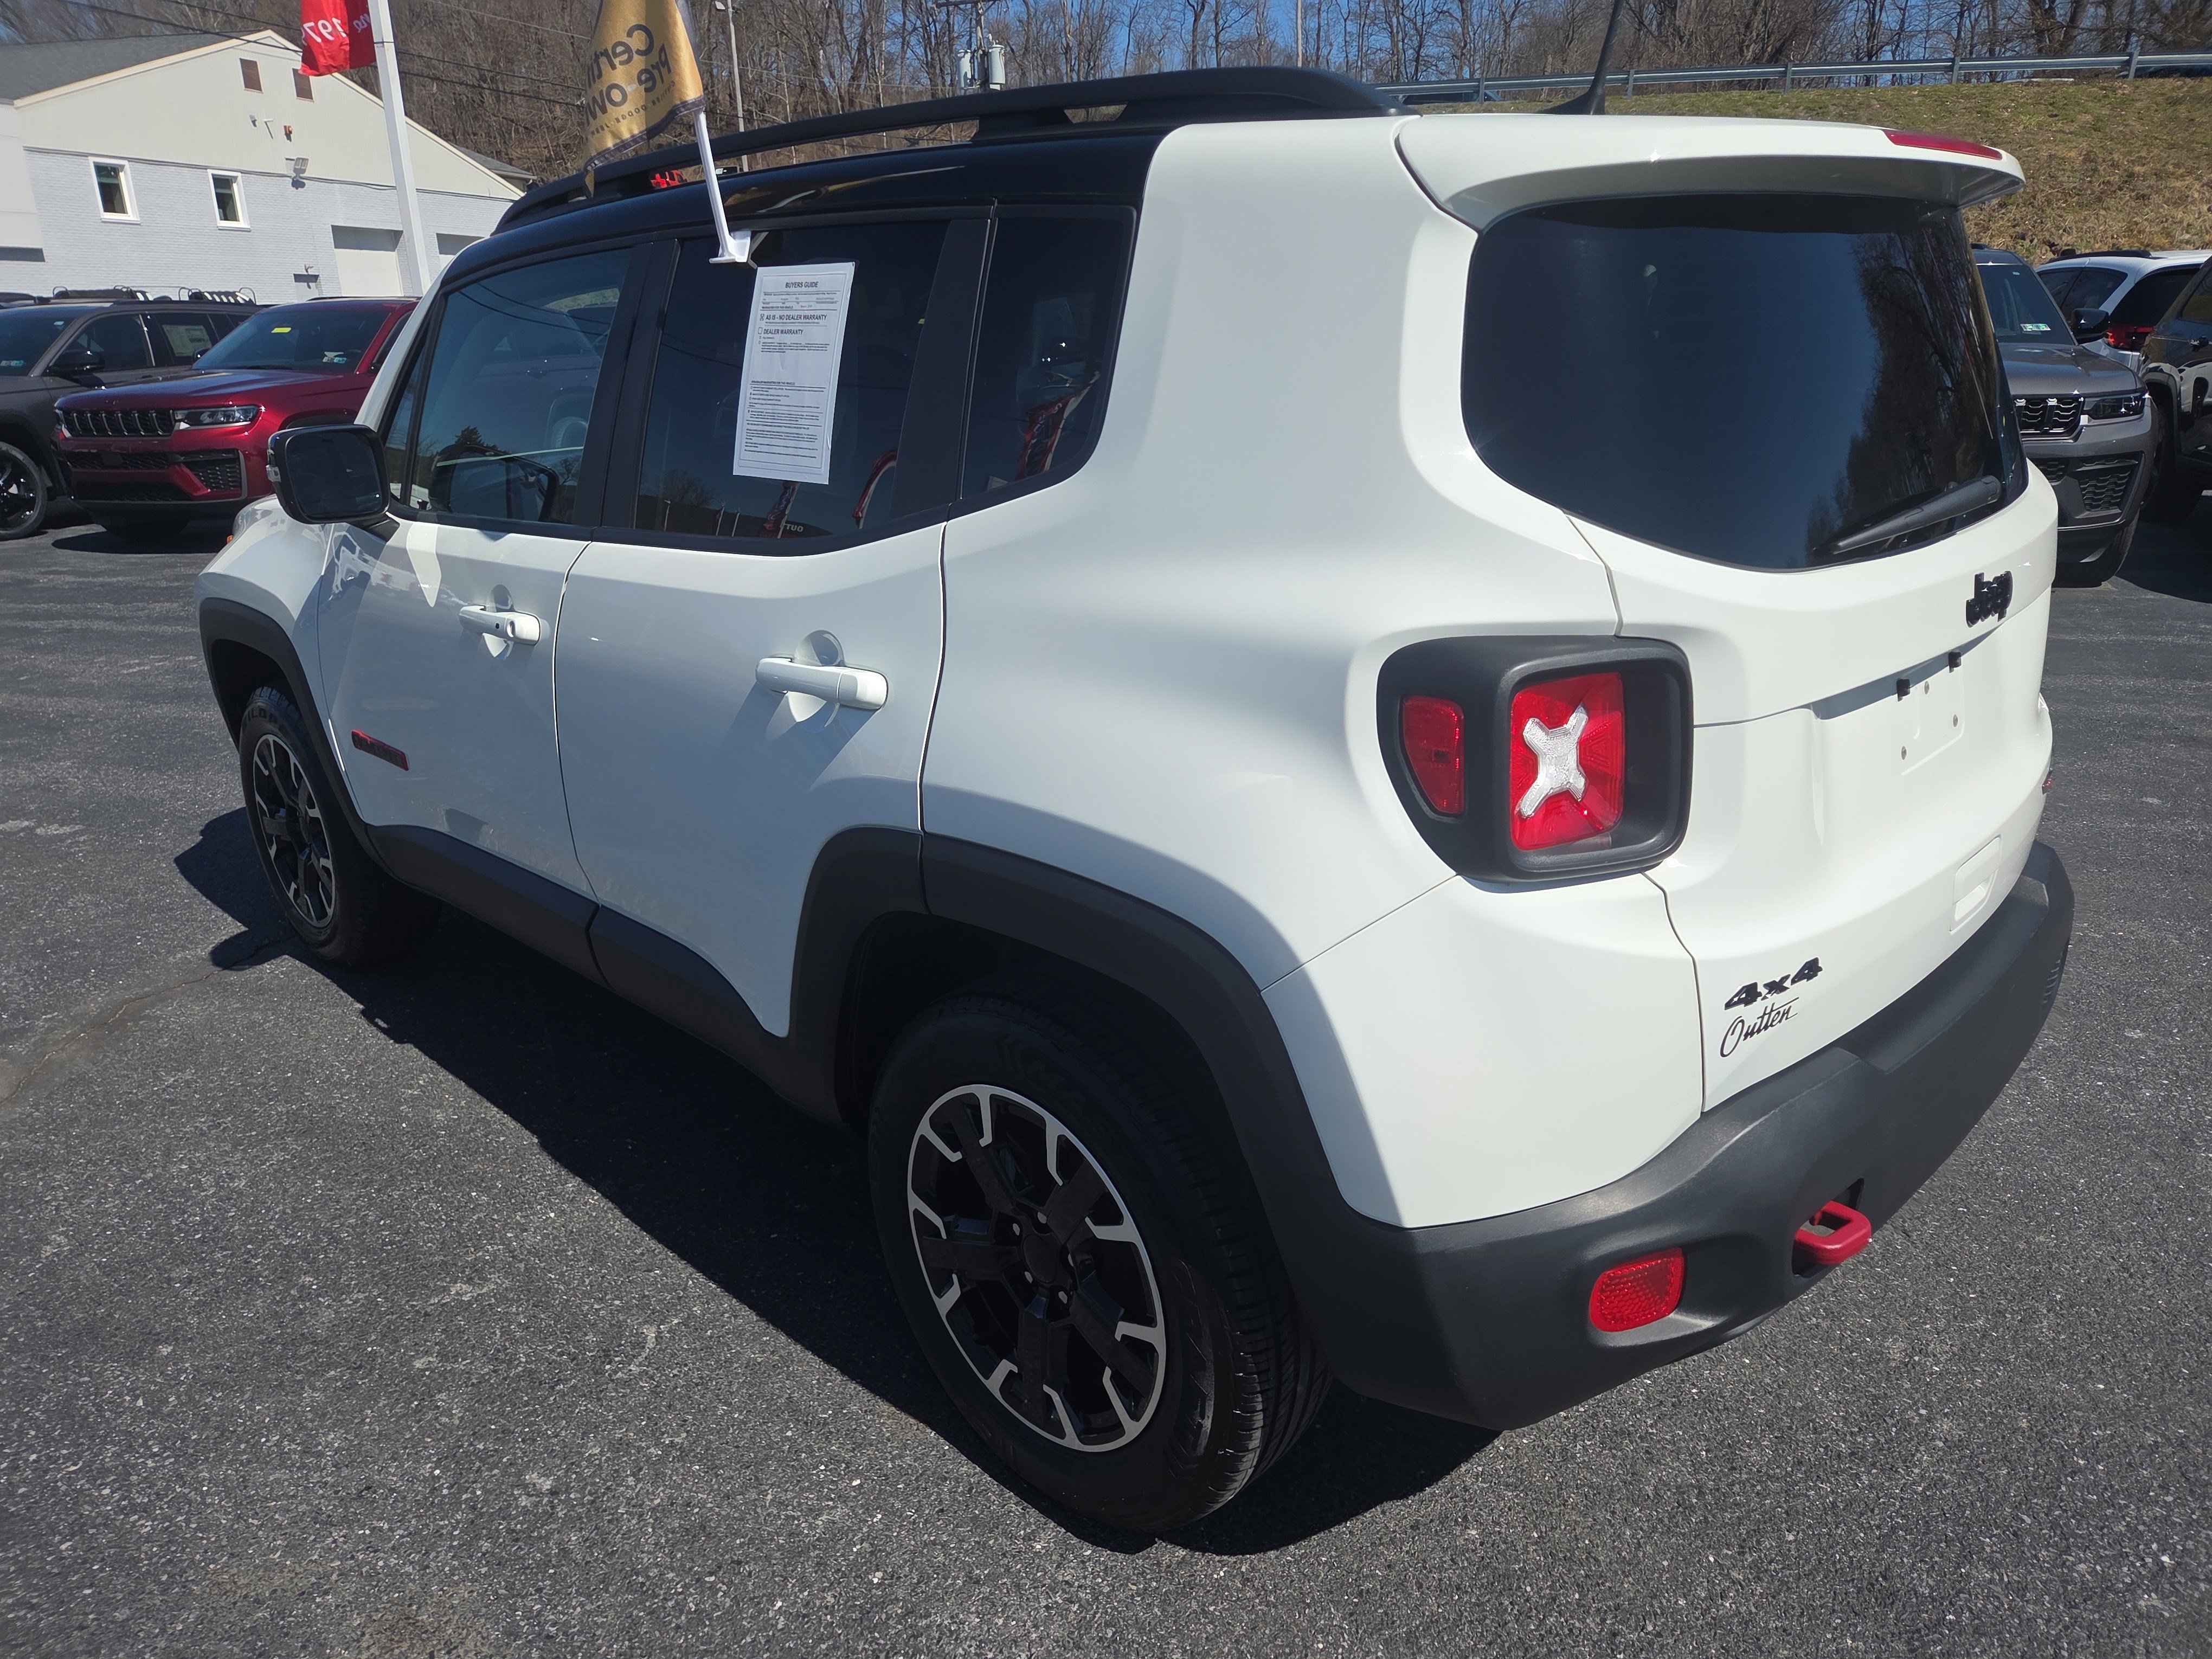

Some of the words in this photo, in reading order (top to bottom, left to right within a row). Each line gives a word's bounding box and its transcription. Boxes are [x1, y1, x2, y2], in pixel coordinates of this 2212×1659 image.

[1965, 570, 2013, 628] Jeep
[1724, 956, 1823, 1011] 4x4
[1720, 998, 1798, 1058] Outten
